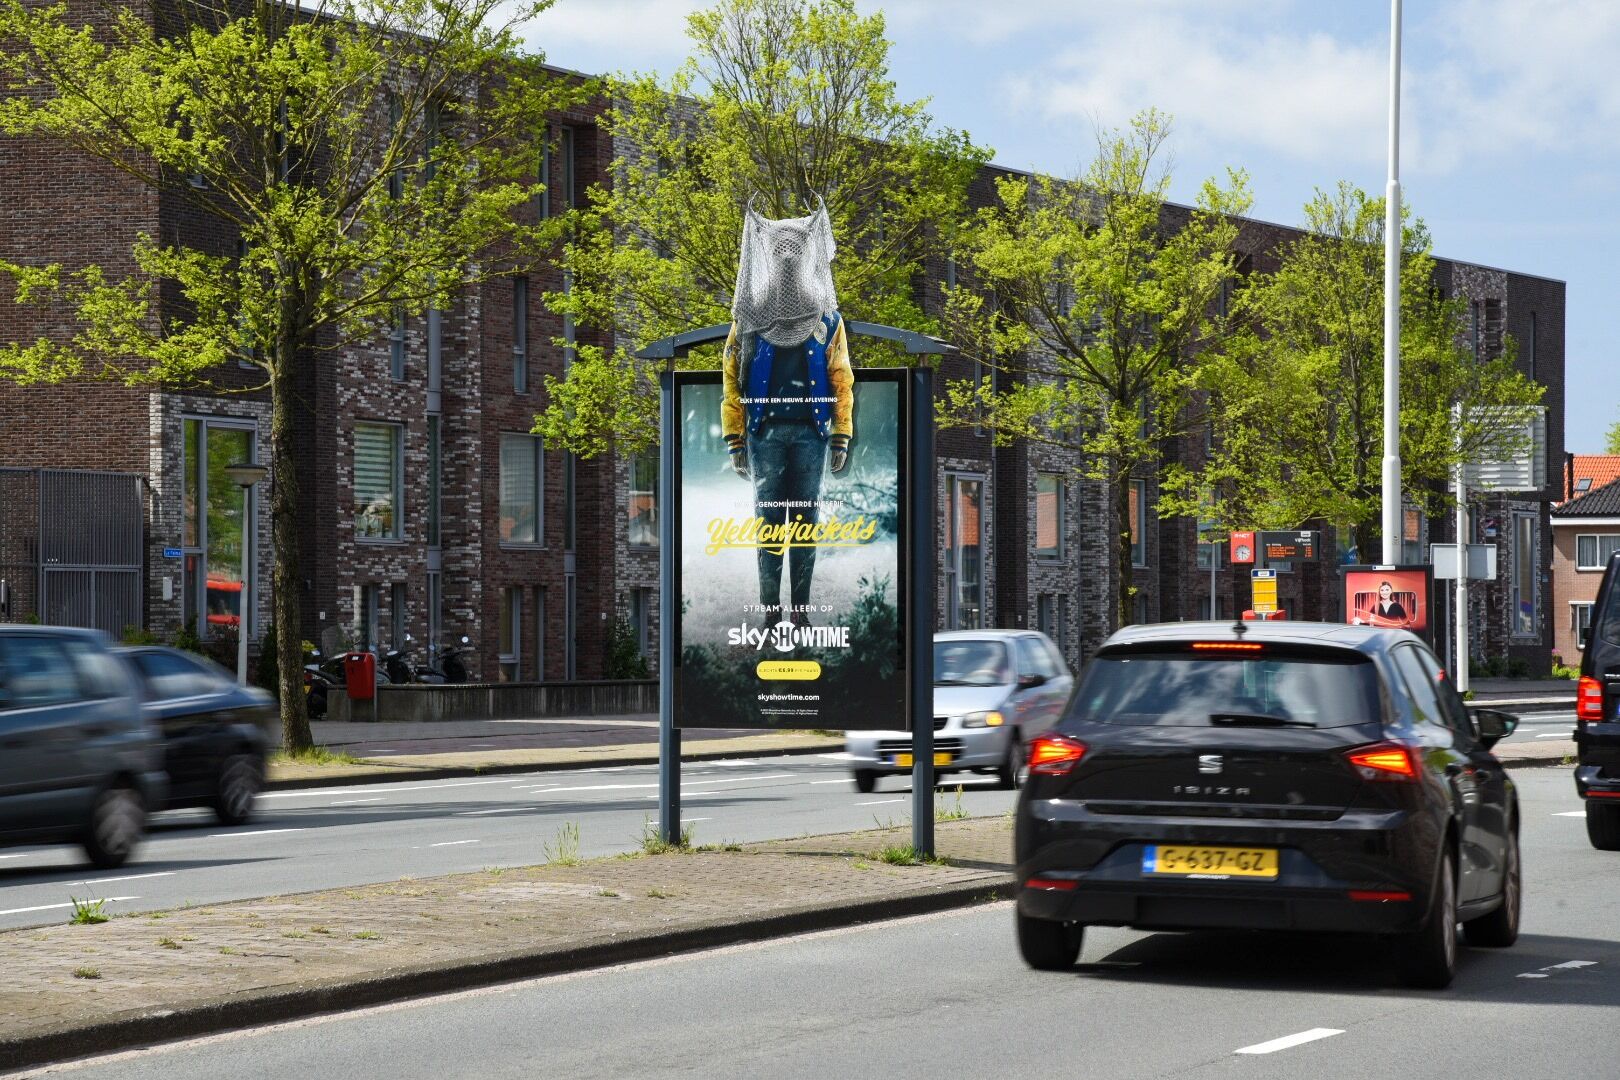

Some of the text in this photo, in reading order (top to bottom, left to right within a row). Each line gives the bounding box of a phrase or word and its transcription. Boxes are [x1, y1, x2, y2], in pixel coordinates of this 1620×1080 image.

[704, 514, 878, 555] Yellowjackets
[743, 604, 834, 613] STREAM ALLEEN OP
[757, 693, 820, 702] skyshowtime.com
[1173, 785, 1250, 796] IBIZA
[1161, 849, 1266, 872] G-637-GZ
